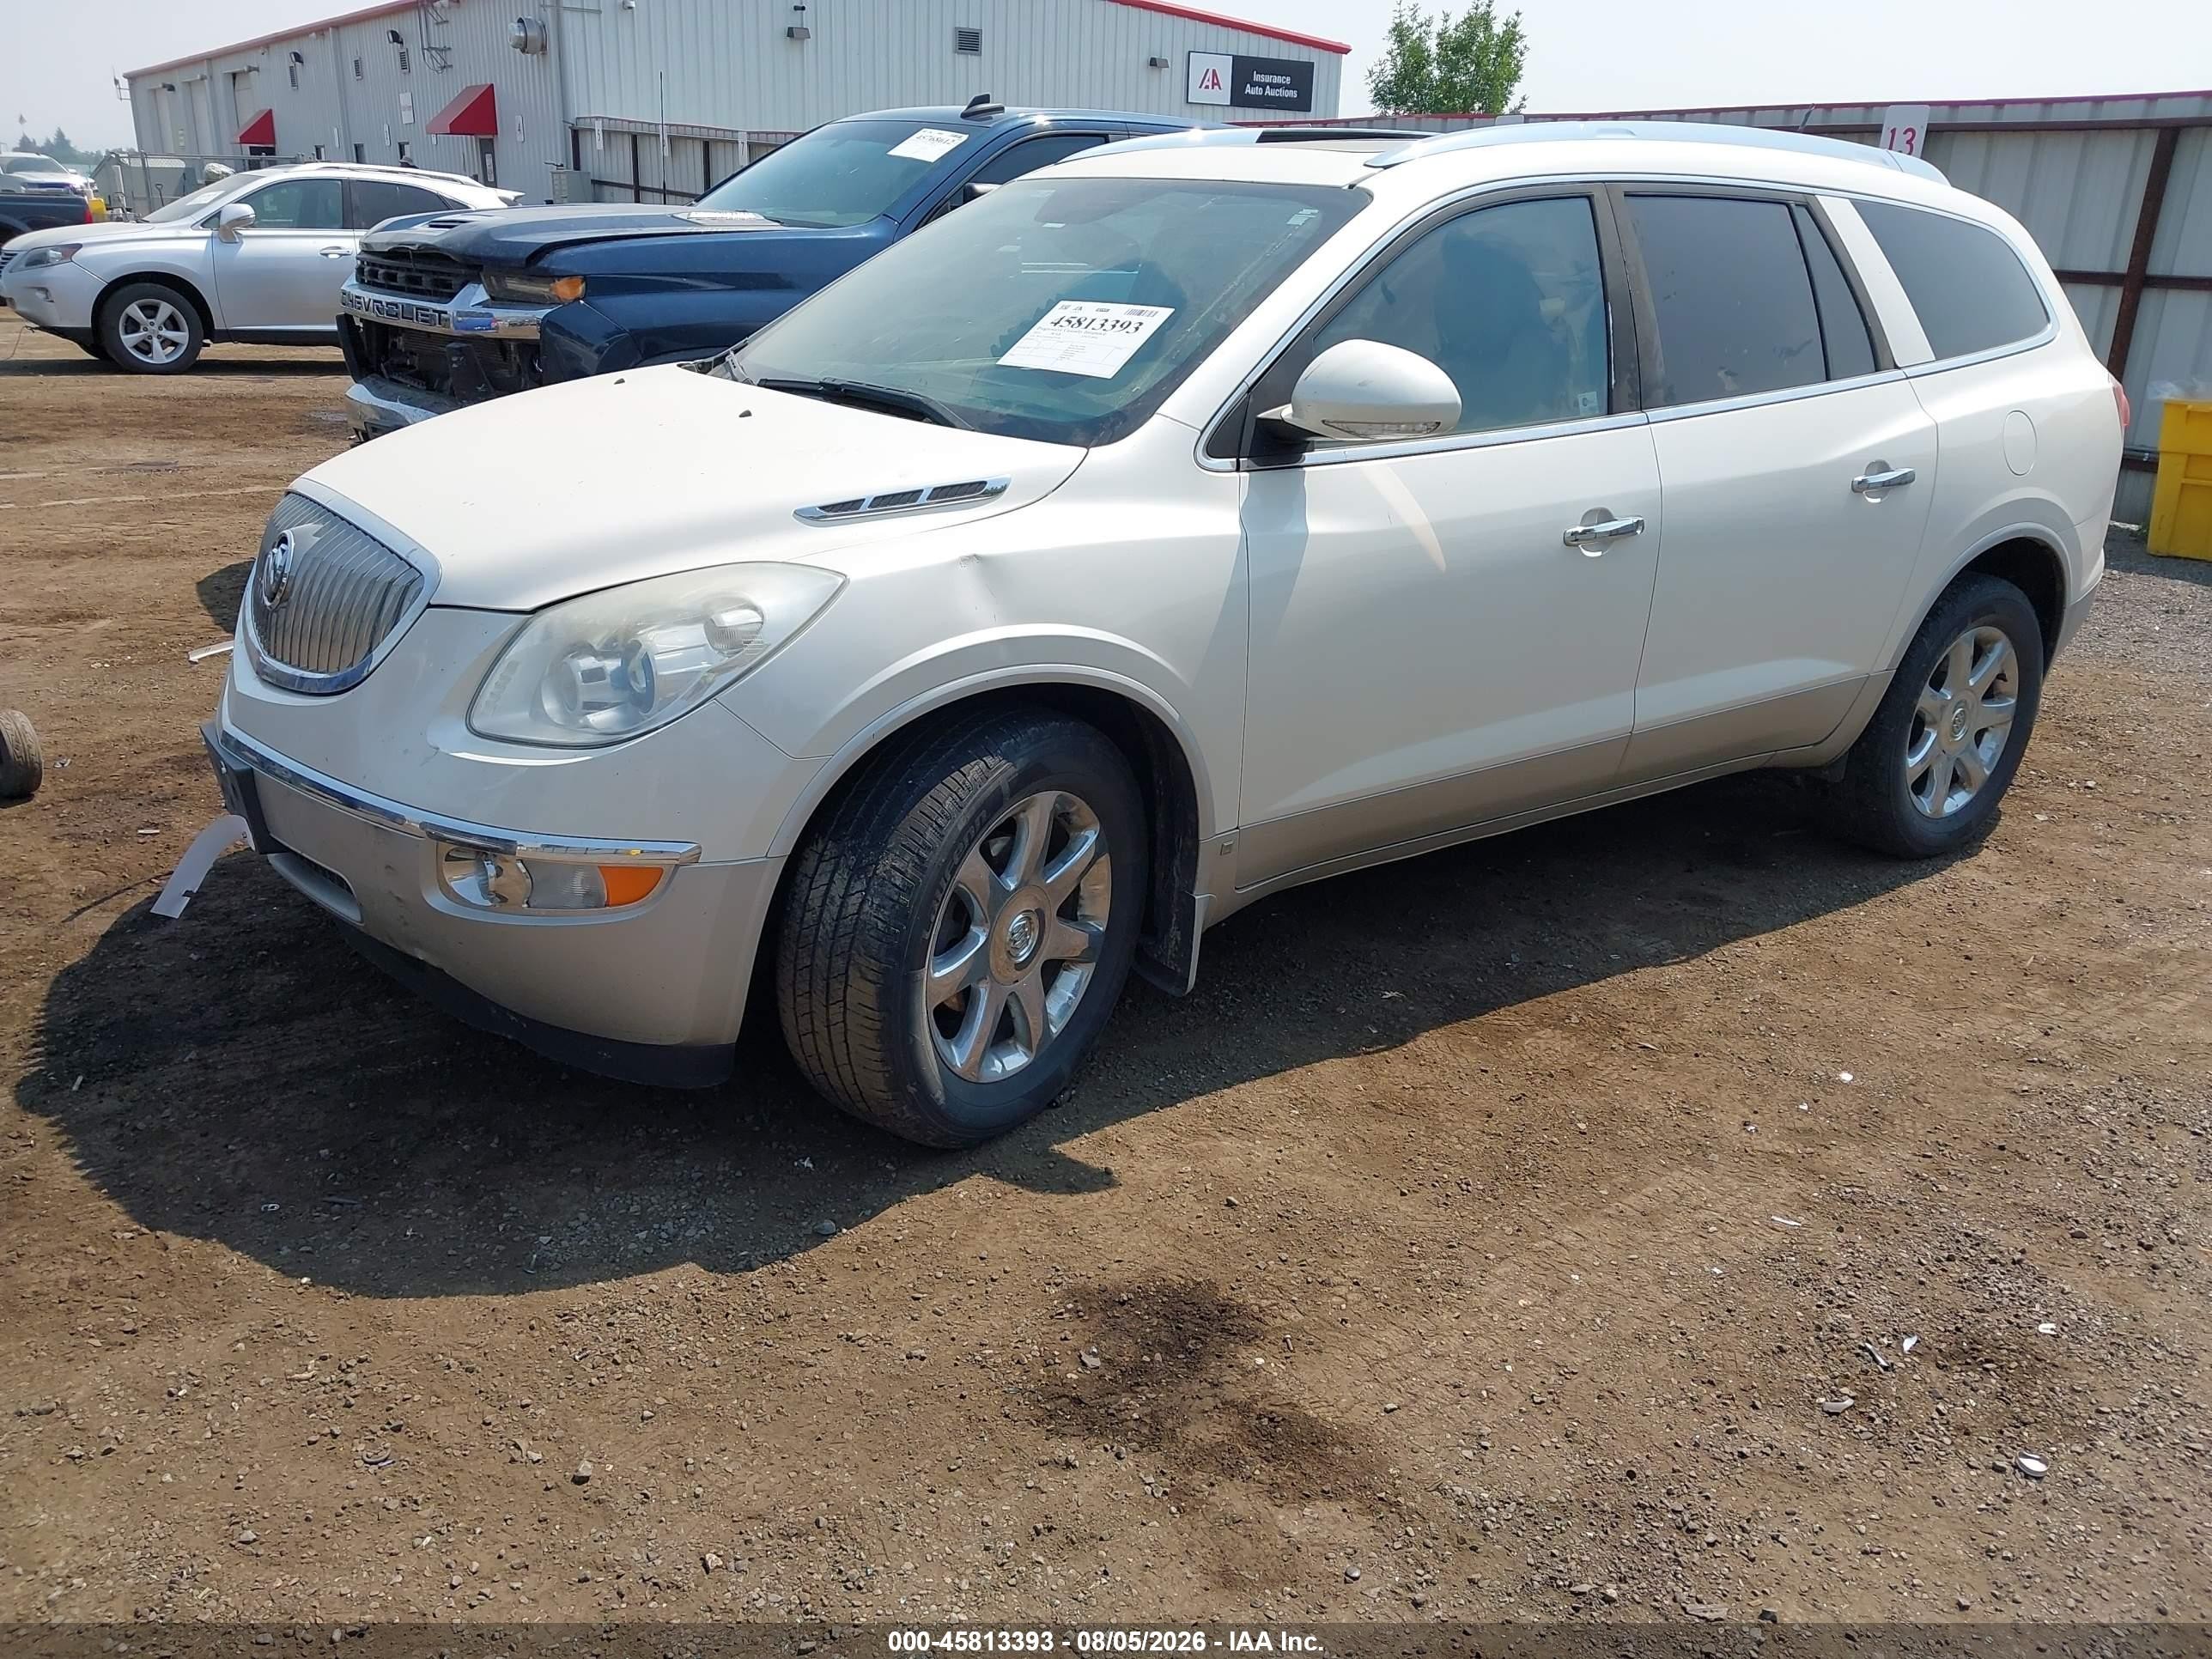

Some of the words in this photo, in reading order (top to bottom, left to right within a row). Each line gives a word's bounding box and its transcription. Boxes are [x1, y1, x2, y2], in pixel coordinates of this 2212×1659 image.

[1253, 70, 1291, 85] Insurance
[1245, 83, 1263, 95] Auto
[1264, 85, 1298, 98] Auctions
[1888, 127, 1917, 155] 13
[340, 290, 448, 326] CHEVROLET
[1049, 315, 1145, 334] 45813393
